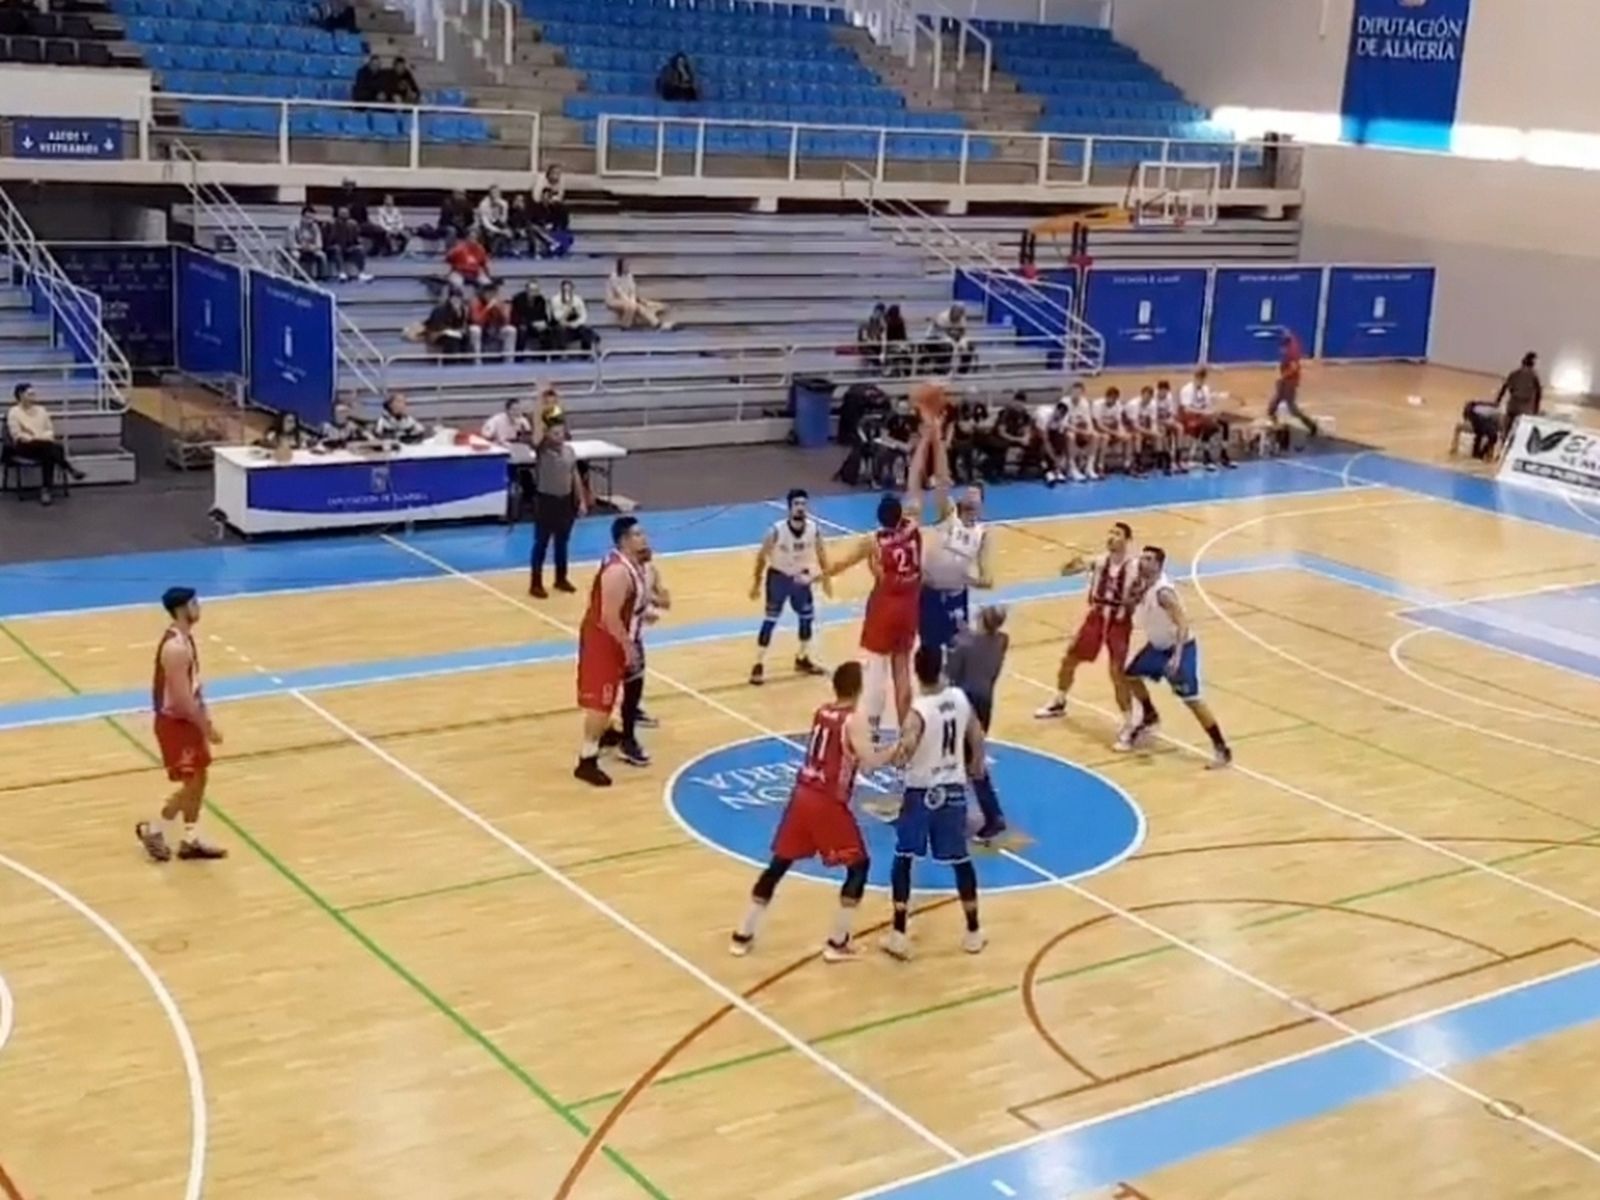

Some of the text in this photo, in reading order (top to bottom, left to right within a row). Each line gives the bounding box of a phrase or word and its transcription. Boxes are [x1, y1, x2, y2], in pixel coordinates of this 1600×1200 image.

[1357, 15, 1462, 38] DIPUTACIÓN
[1356, 38, 1455, 60] DE ALMERÍA
[808, 723, 830, 761] 11
[941, 718, 957, 757] 11
